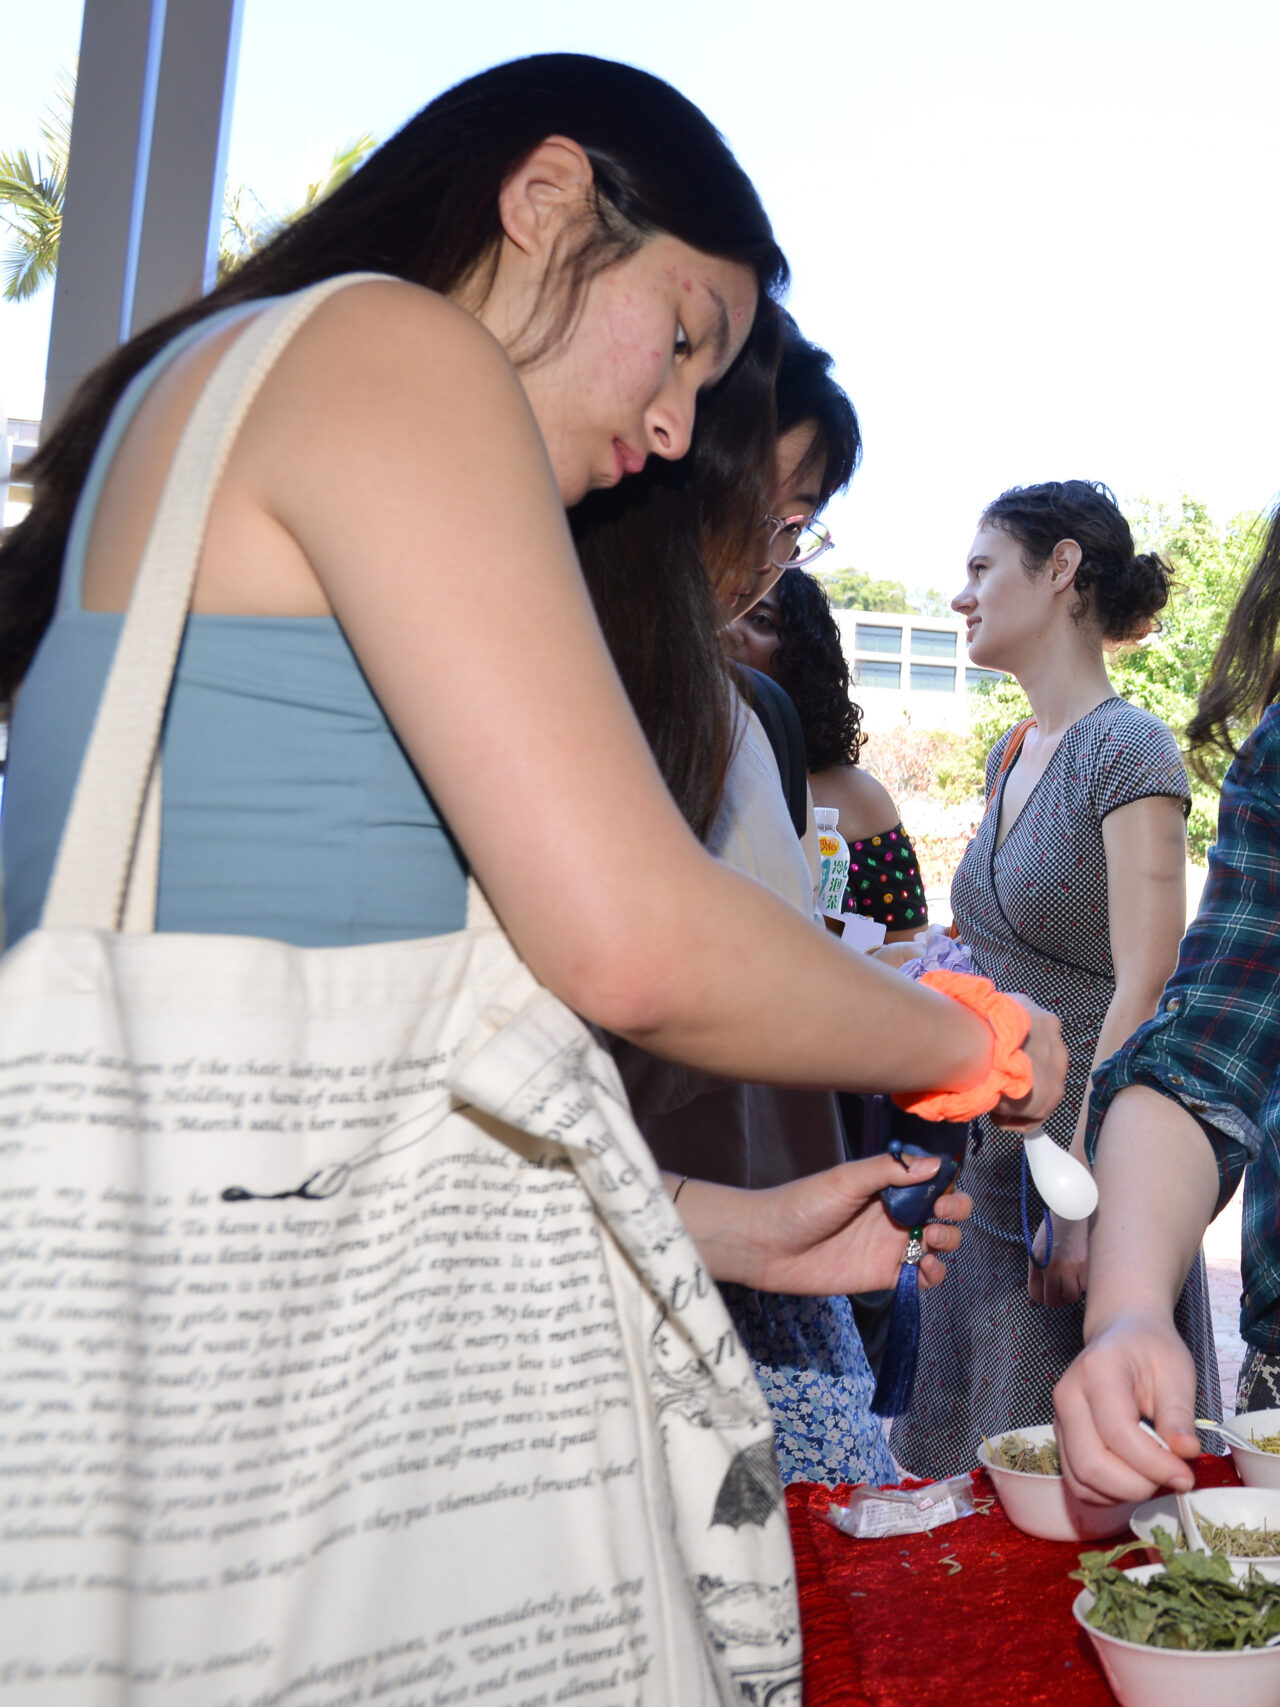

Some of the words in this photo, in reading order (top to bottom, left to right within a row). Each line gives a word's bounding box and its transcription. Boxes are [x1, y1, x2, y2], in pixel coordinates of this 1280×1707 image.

[174, 1112, 242, 1133] March
[481, 1201, 511, 1222] God
[282, 1214, 330, 1238] happy
[461, 1223, 502, 1242] which
[520, 1301, 552, 1319] dear
[463, 1332, 509, 1352] marry
[454, 1358, 511, 1376] because
